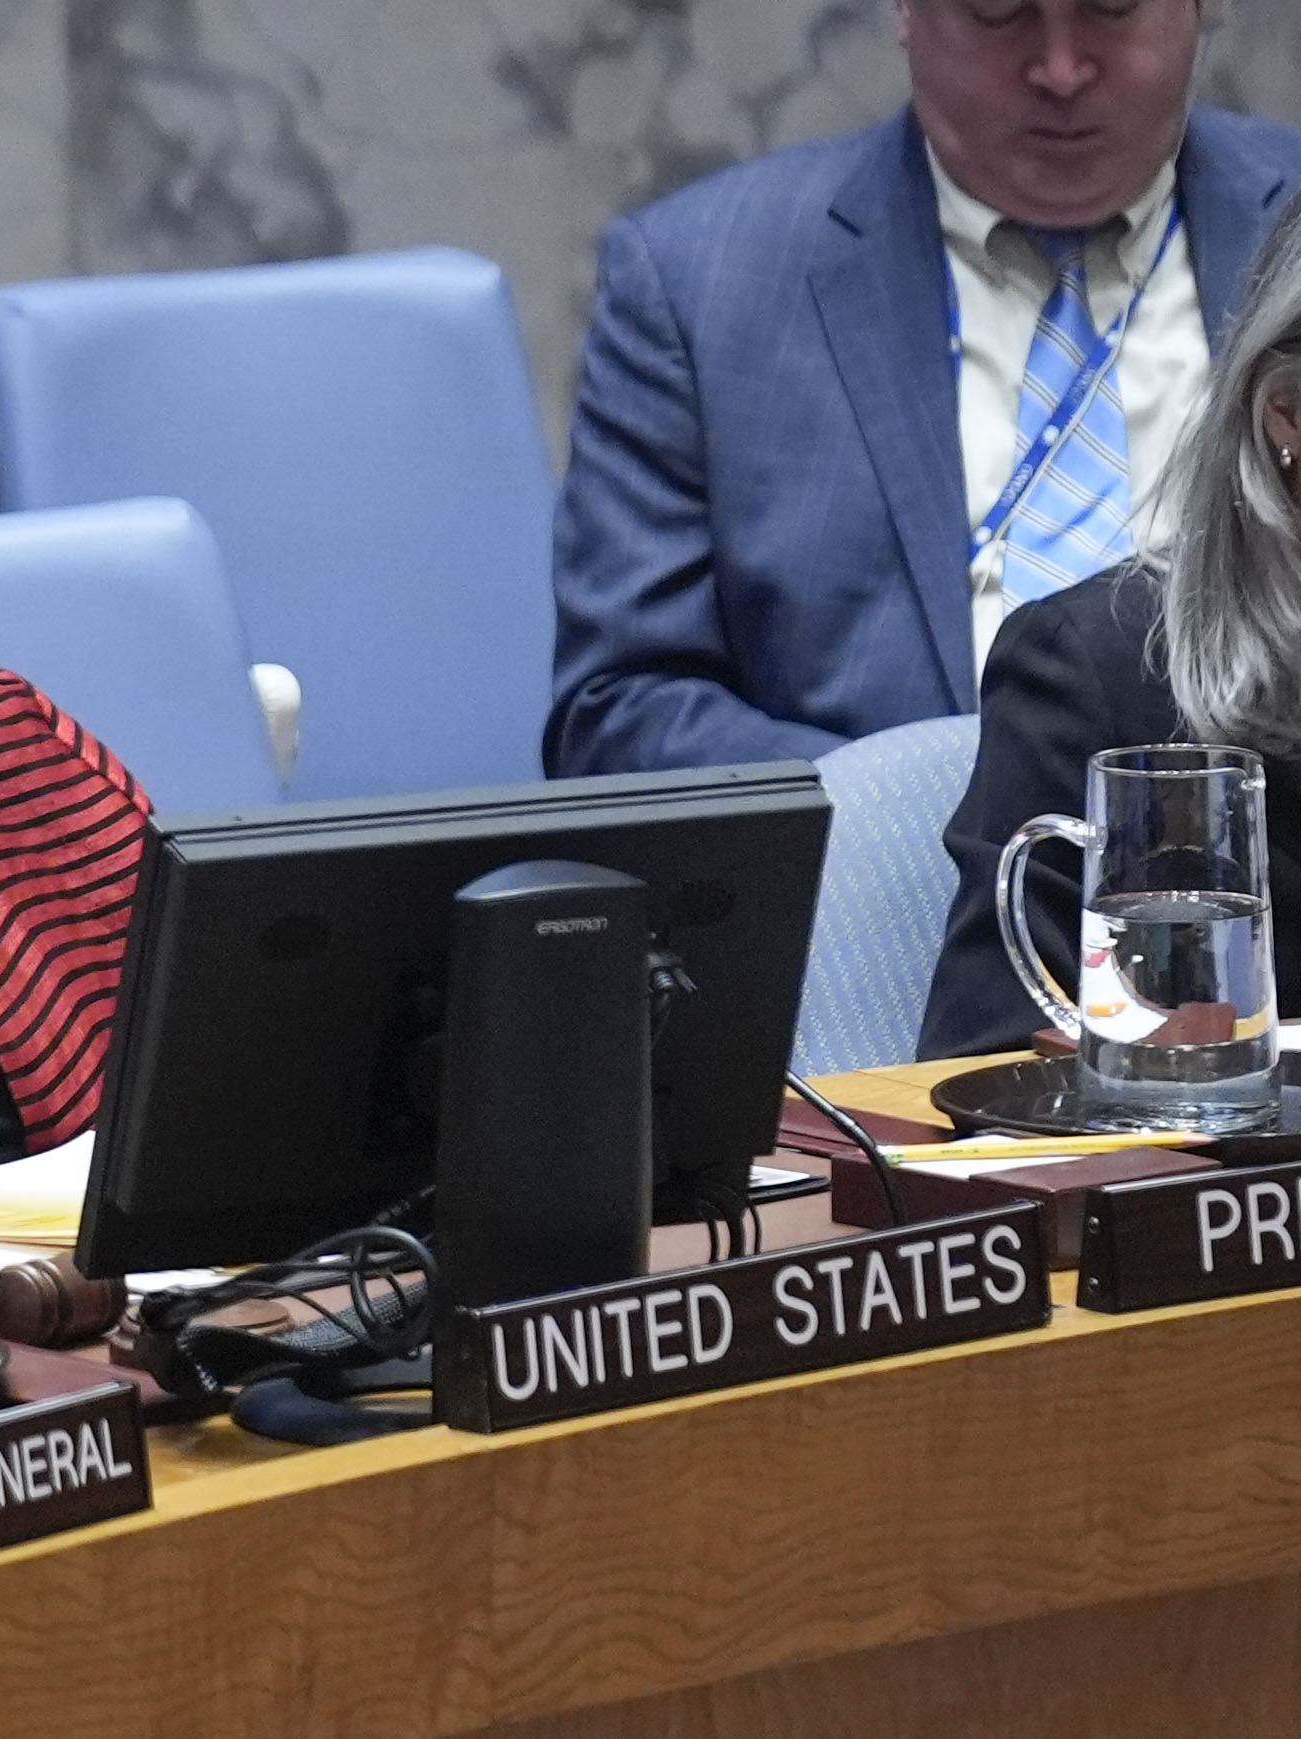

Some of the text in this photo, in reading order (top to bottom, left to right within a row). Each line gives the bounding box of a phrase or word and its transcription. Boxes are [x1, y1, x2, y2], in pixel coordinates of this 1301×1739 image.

[1198, 1177, 1301, 1273] PR
[491, 1225, 1026, 1402] UNITED STATES
